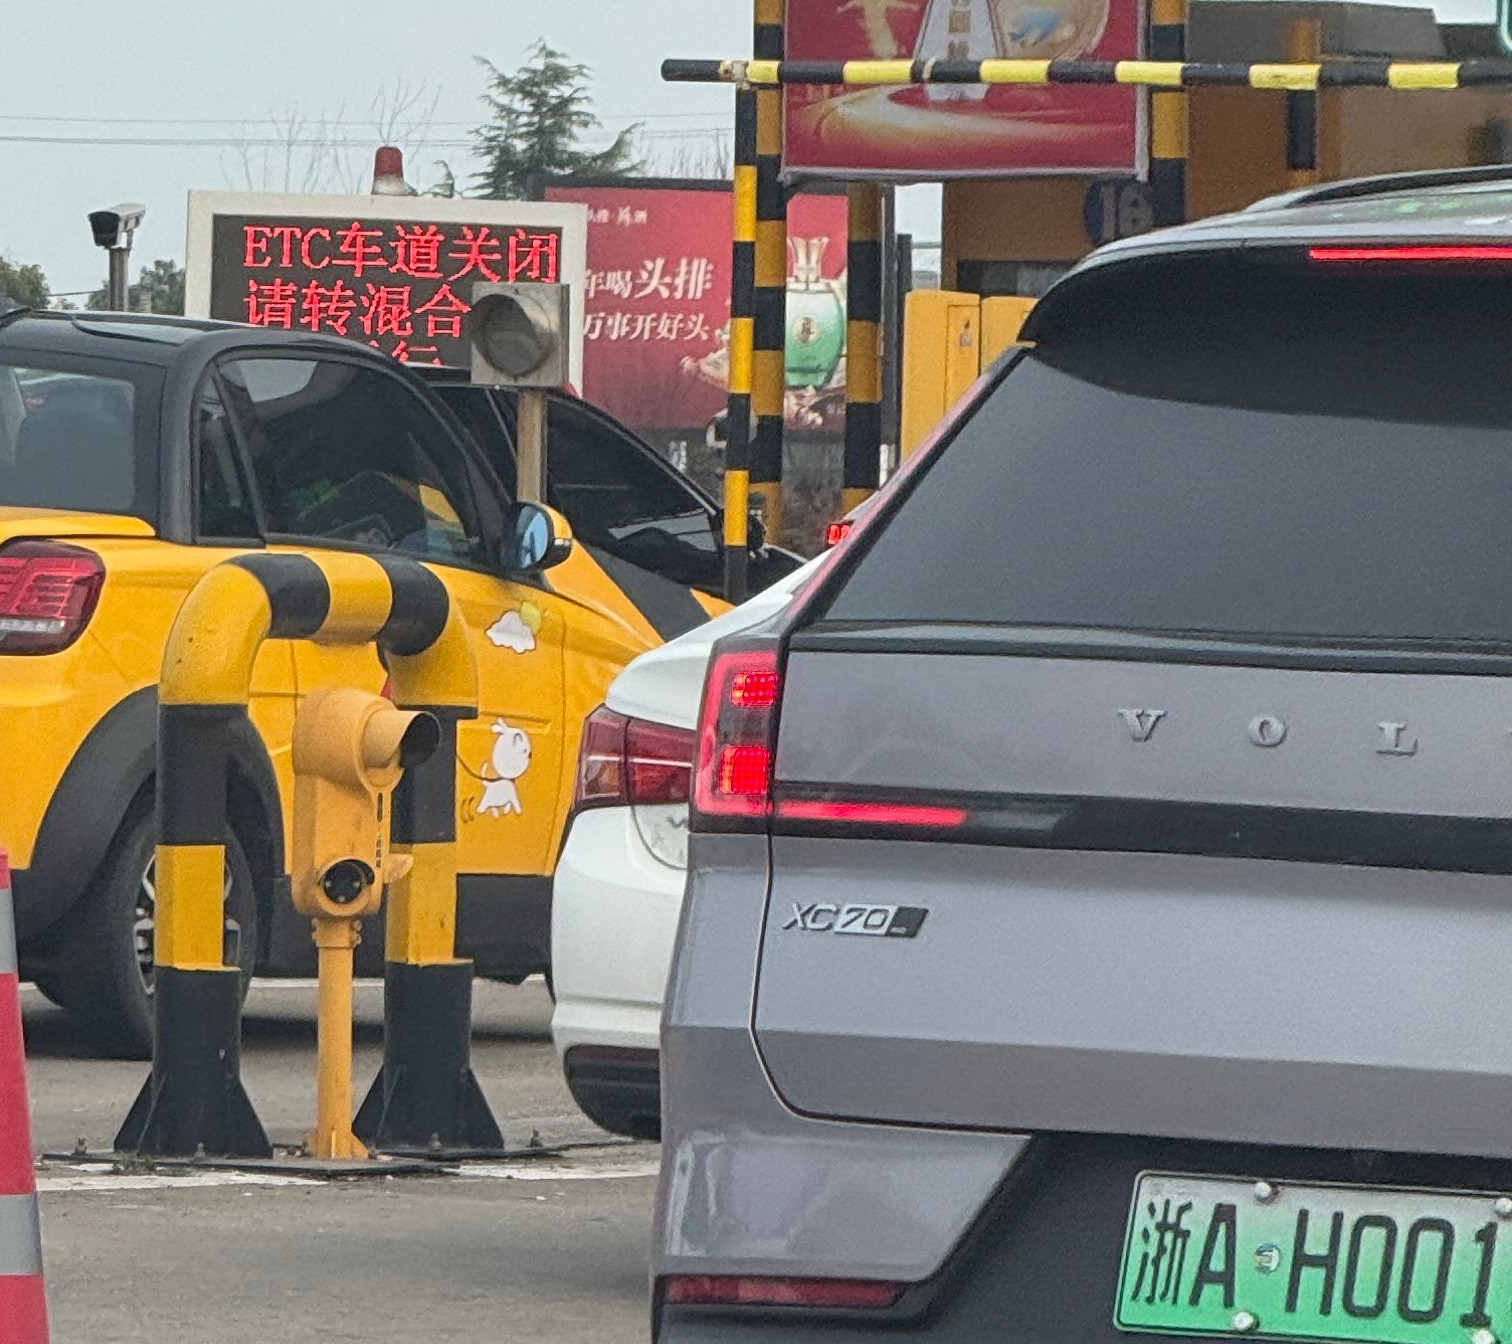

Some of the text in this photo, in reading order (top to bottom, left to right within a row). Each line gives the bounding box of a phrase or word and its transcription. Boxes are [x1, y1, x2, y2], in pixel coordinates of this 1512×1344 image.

[242, 221, 560, 283] ETC车道关闭
[243, 278, 472, 338] 请转混合
[583, 311, 711, 341] 万事开好头
[782, 901, 894, 934] XC70
